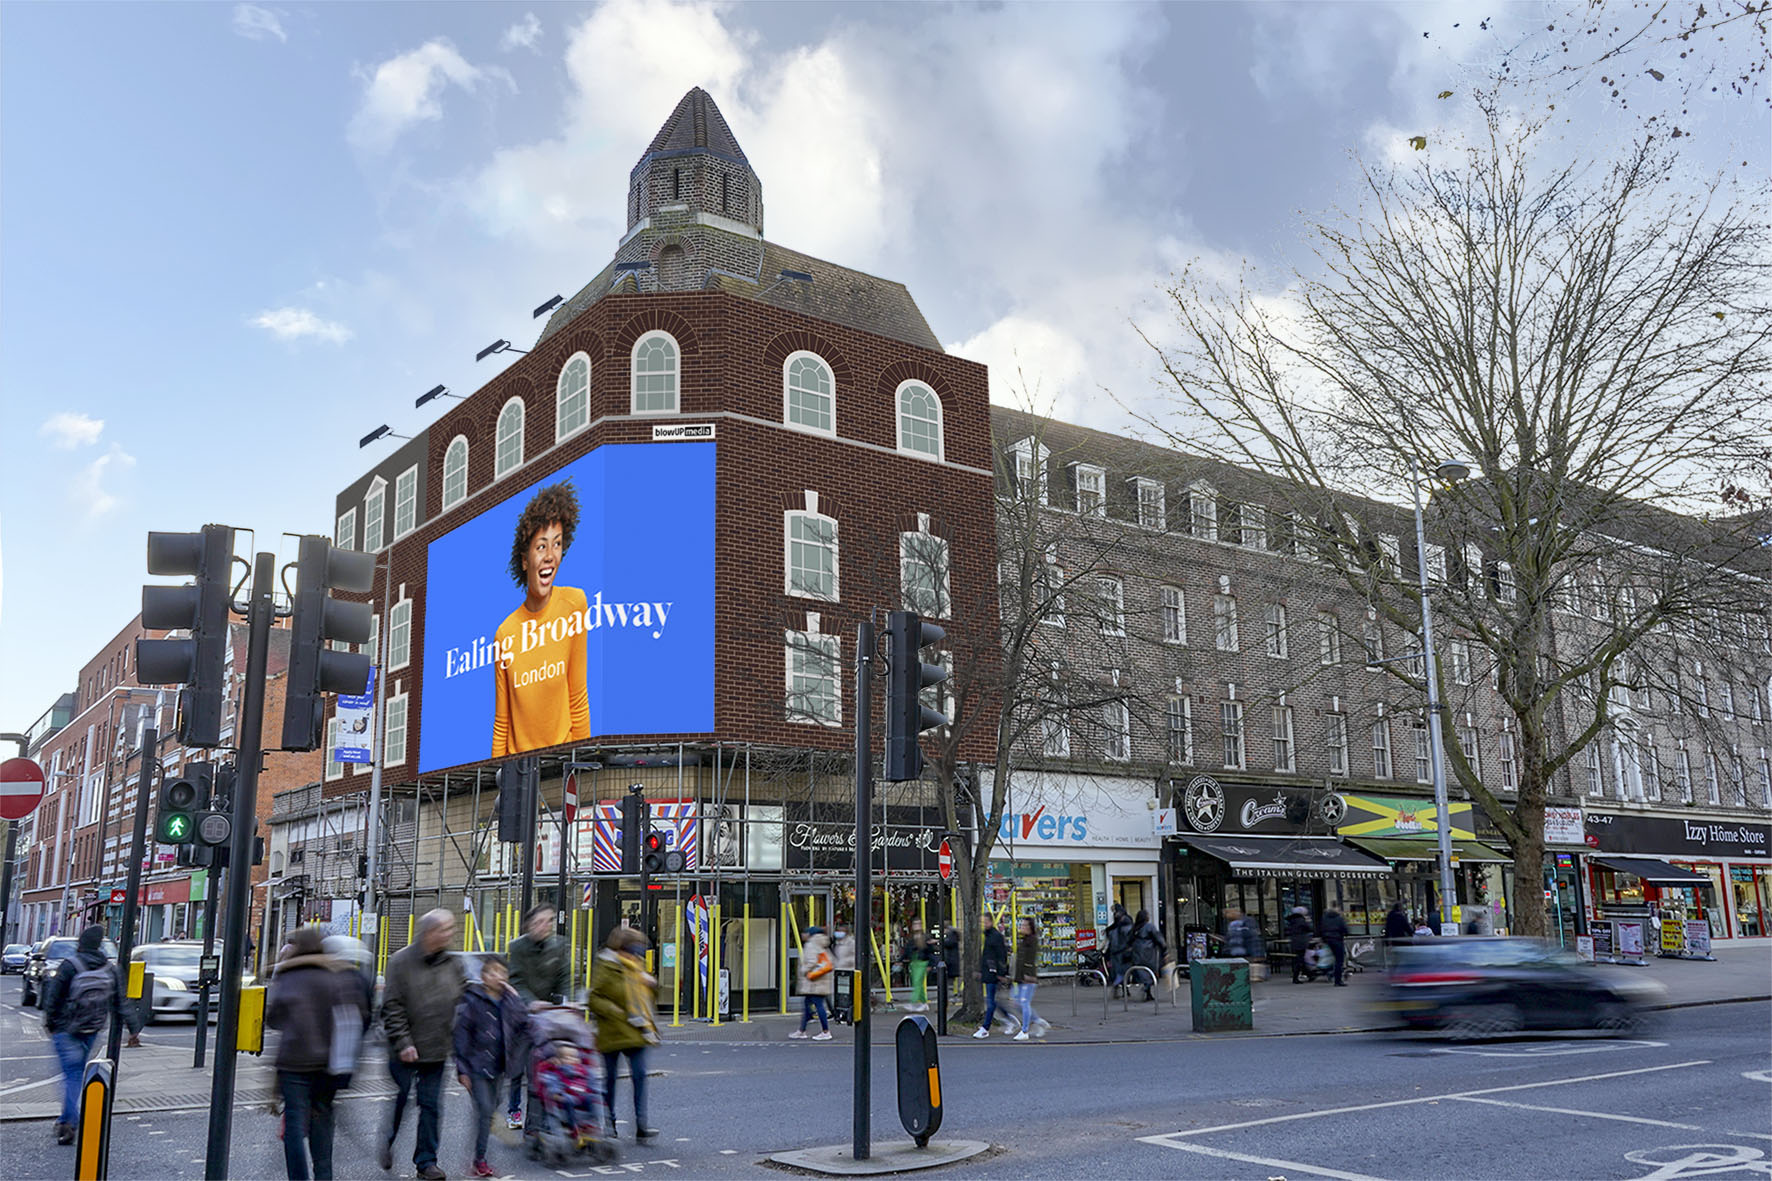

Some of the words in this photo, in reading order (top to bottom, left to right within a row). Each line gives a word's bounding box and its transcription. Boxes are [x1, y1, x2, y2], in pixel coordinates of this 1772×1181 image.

[445, 635, 516, 679] Ealing
[520, 591, 674, 654] Broadway
[513, 659, 566, 688] London
[1240, 798, 1287, 829] Cream's
[1587, 815, 1614, 824] 43-47
[789, 823, 844, 847] Flowers
[1684, 820, 1707, 846] Izzy
[1740, 826, 1765, 844] Store
[1235, 868, 1254, 877] THE
[1256, 869, 1294, 878] ITALIAN
[1296, 870, 1330, 878] GELATO
[1340, 871, 1377, 879] DESSERT
[555, 1159, 681, 1178] LEFT
